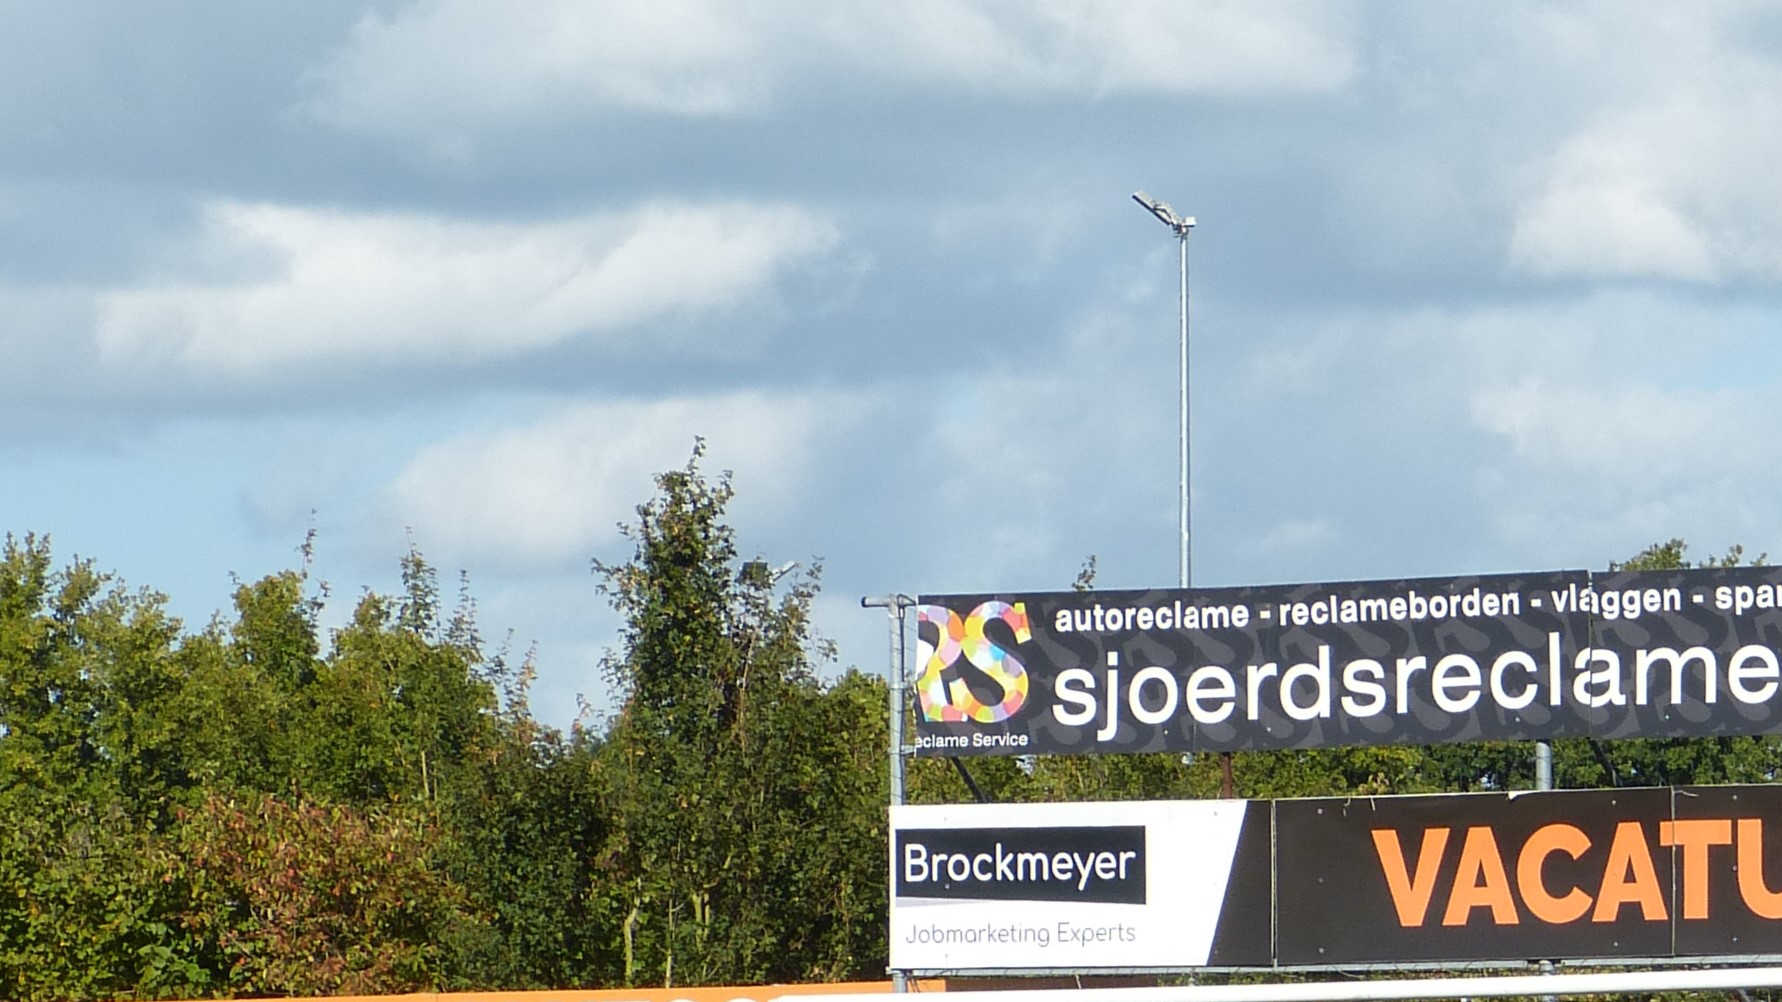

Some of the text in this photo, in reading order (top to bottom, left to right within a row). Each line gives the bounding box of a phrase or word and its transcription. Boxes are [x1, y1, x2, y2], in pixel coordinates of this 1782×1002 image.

[1055, 601, 1249, 633] autoreclame
[1279, 590, 1520, 627] reclameborden
[1551, 581, 1681, 621] vlaggen
[972, 732, 1028, 747] Service
[904, 843, 1137, 891] Brockmeyer
[906, 921, 1137, 948] Jobmarketing Experts
